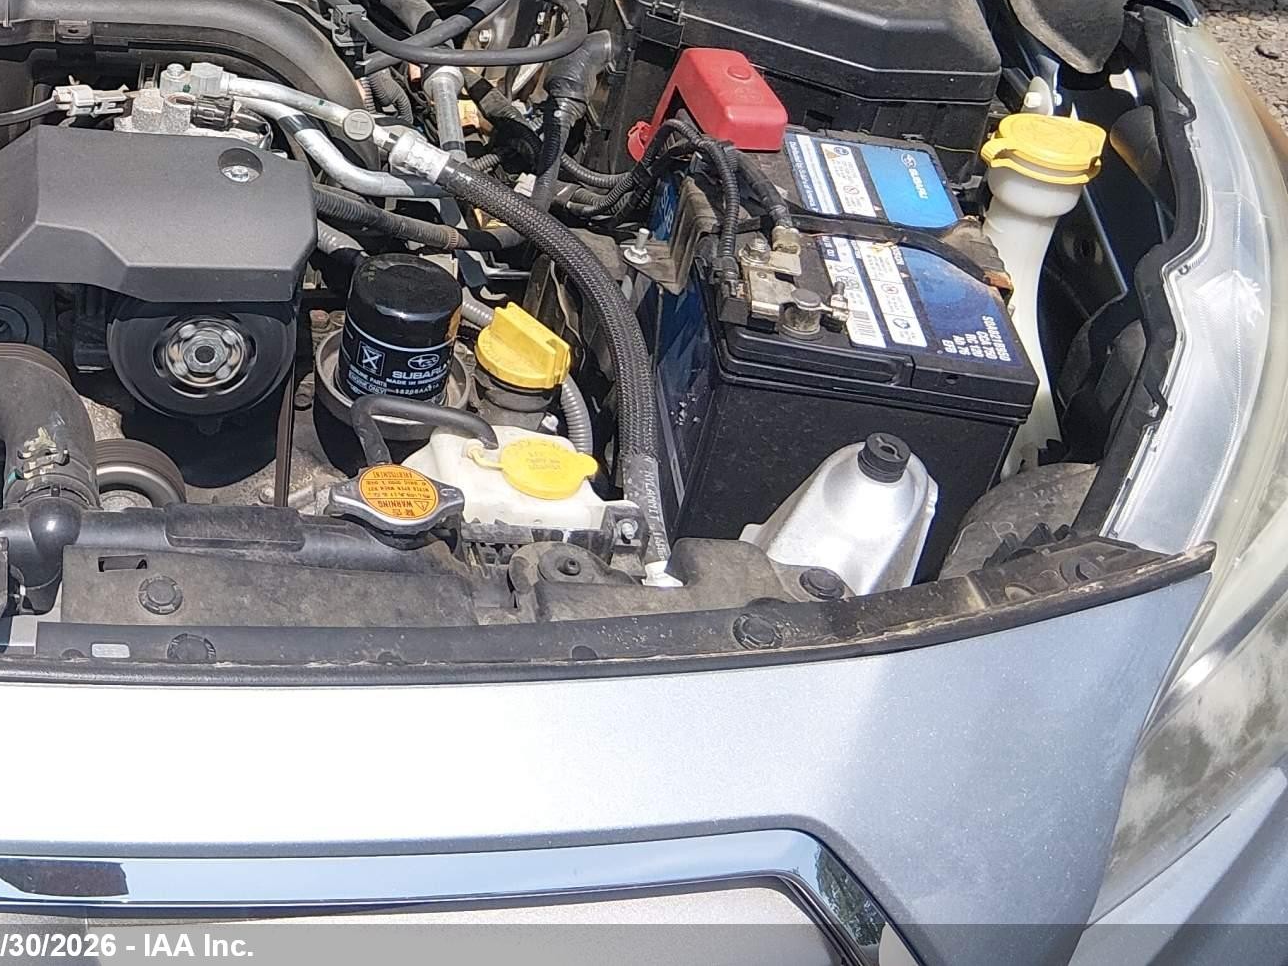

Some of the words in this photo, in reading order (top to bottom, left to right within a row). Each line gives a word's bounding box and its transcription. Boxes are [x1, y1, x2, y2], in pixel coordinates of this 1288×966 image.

[909, 168, 929, 199] SUBARU
[942, 338, 958, 354] EFB
[965, 333, 980, 345] RC
[976, 330, 992, 346] CCA
[969, 344, 985, 358] 120
[392, 363, 447, 380] SUBARU
[377, 500, 413, 508] WARNING
